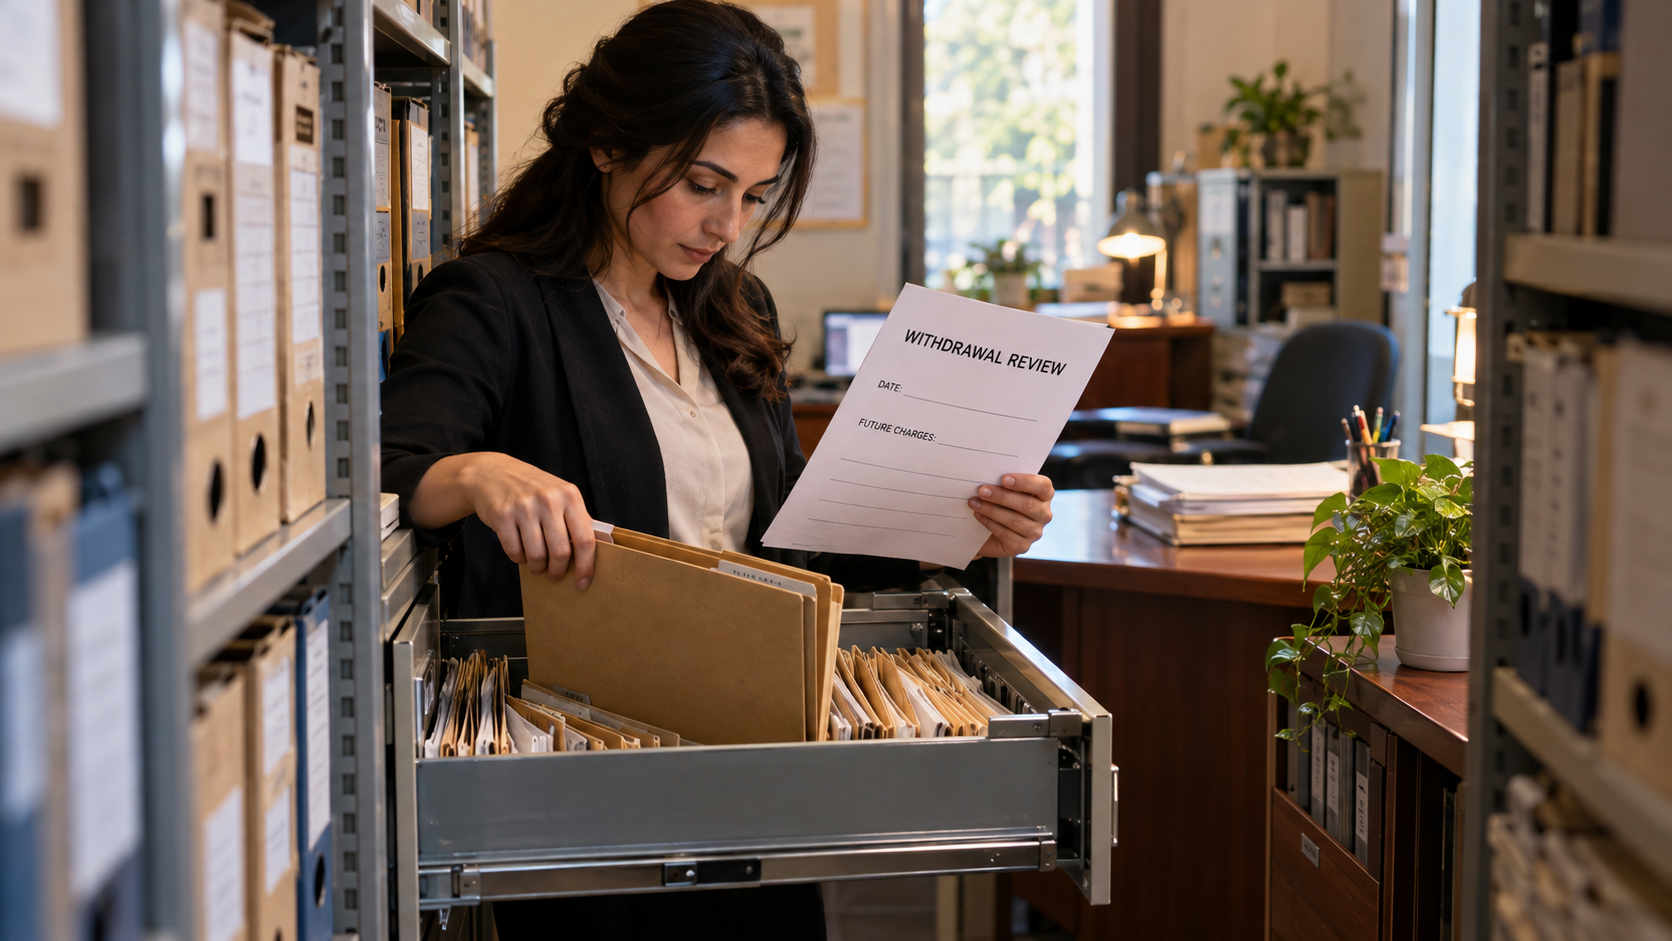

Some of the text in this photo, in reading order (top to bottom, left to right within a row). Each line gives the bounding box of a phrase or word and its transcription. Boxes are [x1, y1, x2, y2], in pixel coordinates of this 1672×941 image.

[904, 329, 1067, 376] WITHDRAWAL REVIEW
[878, 380, 902, 393] DATE:
[858, 418, 936, 442] FUTURE CHARGES:
